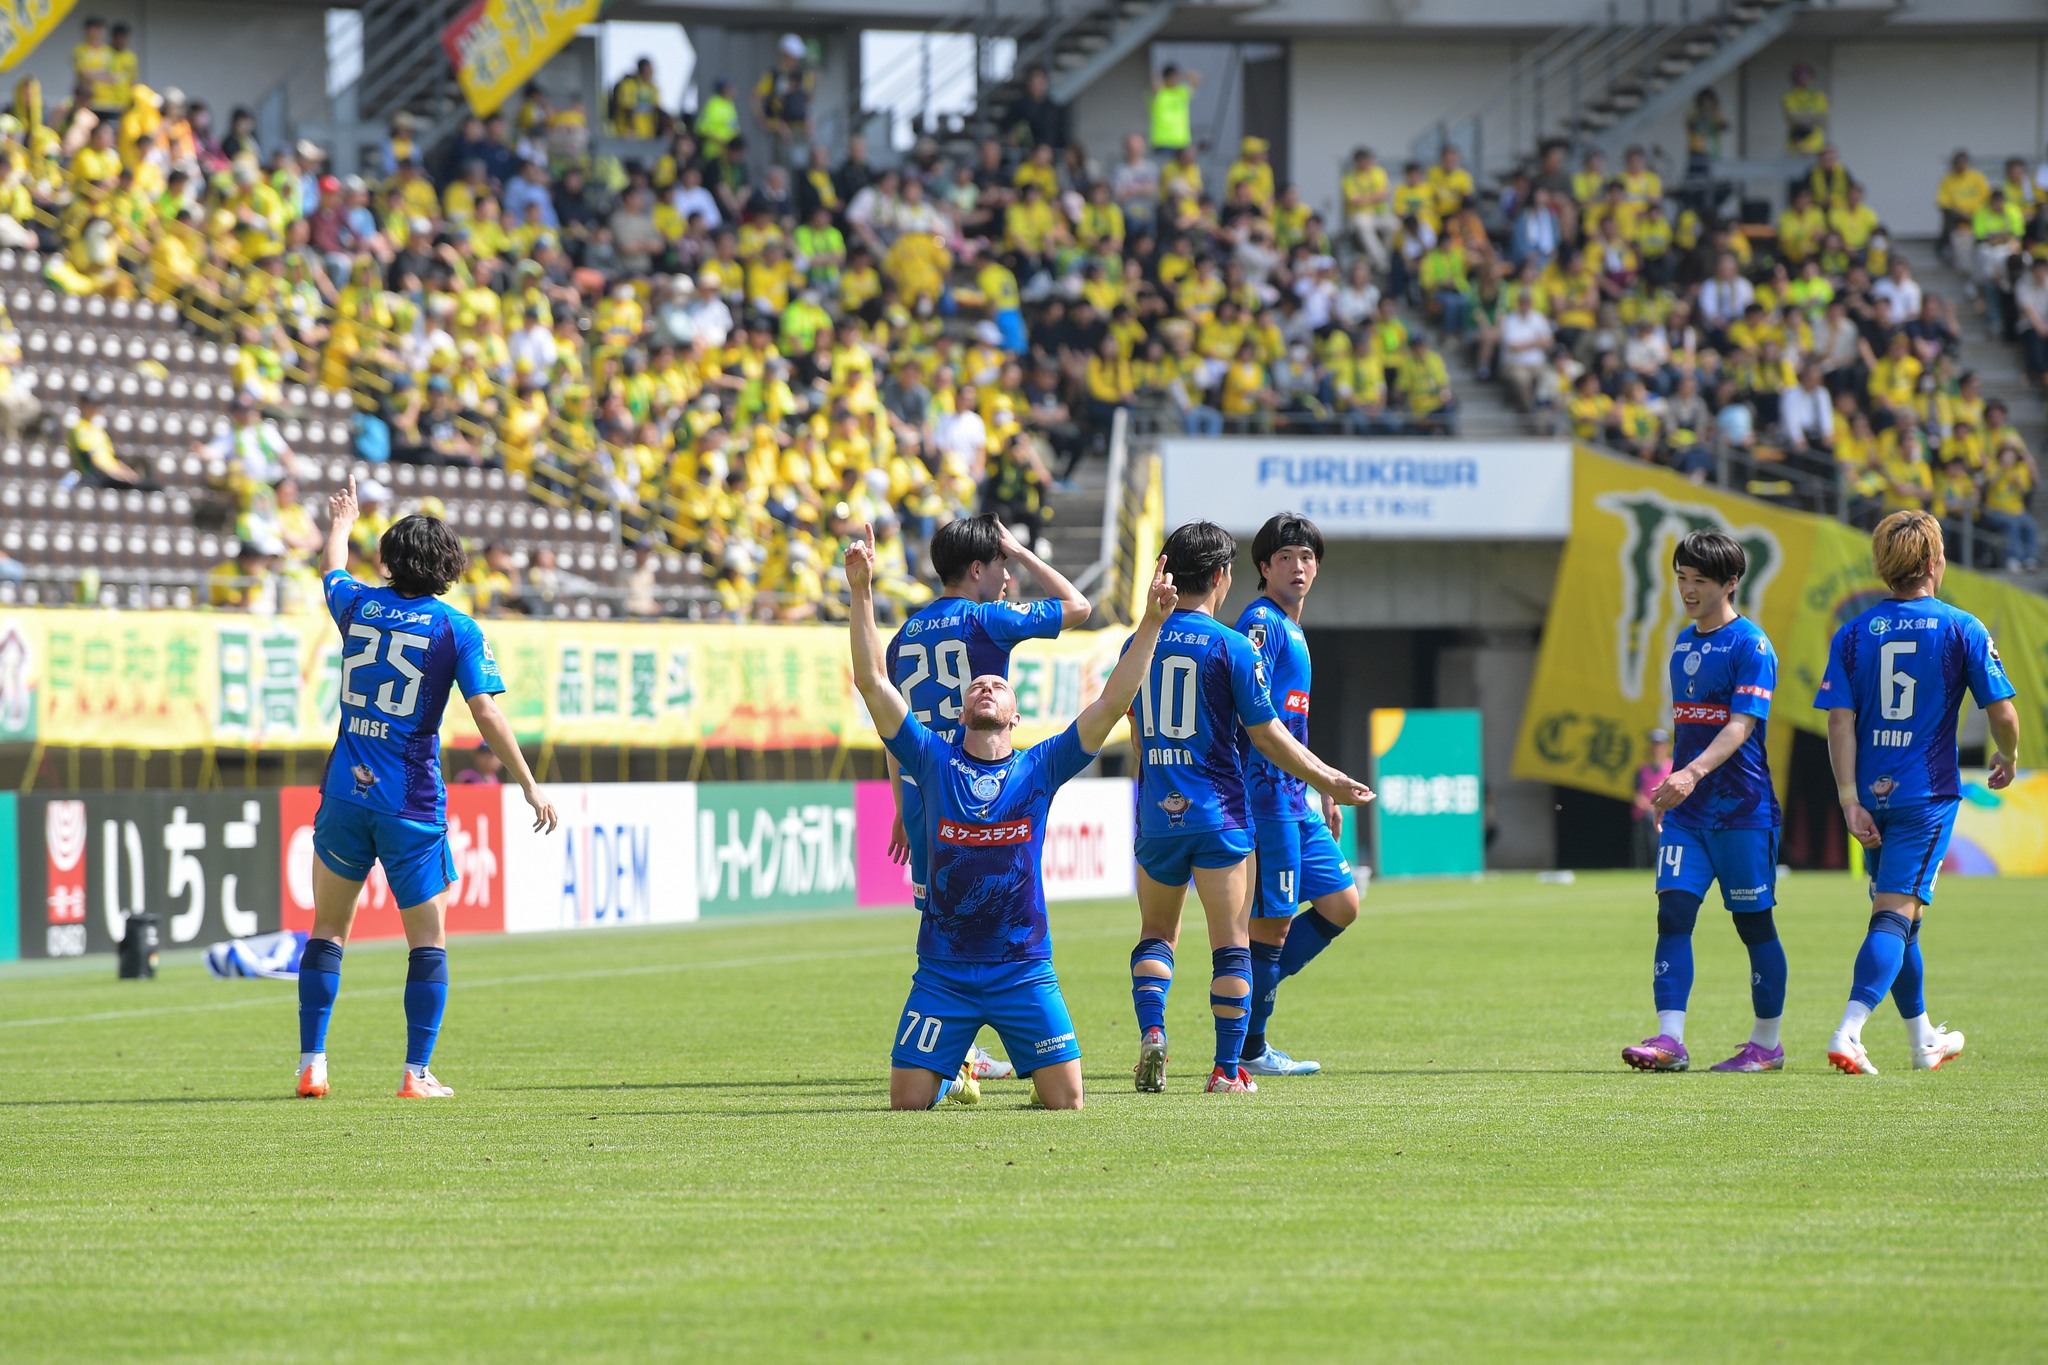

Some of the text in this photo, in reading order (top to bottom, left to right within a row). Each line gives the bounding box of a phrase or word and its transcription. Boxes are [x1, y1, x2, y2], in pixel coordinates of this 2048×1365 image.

[1257, 455, 1479, 488] FURUKAWA
[1301, 496, 1436, 518] ELECTRIC
[1164, 631, 1210, 646] JX金属
[1895, 618, 1939, 631] JX金属
[342, 623, 430, 717] 25
[898, 639, 973, 723] 29
[1880, 641, 1917, 721] 6
[1140, 654, 1198, 740] 10
[348, 716, 390, 739] MASE
[1873, 729, 1913, 747] TAKA
[958, 823, 1029, 841] ケーズデンキ
[103, 800, 261, 943] いちご
[1657, 845, 1683, 878] 14
[1279, 870, 1294, 903] 4
[899, 1010, 943, 1053] 70
[1036, 1042, 1066, 1055] HOLDINGS
